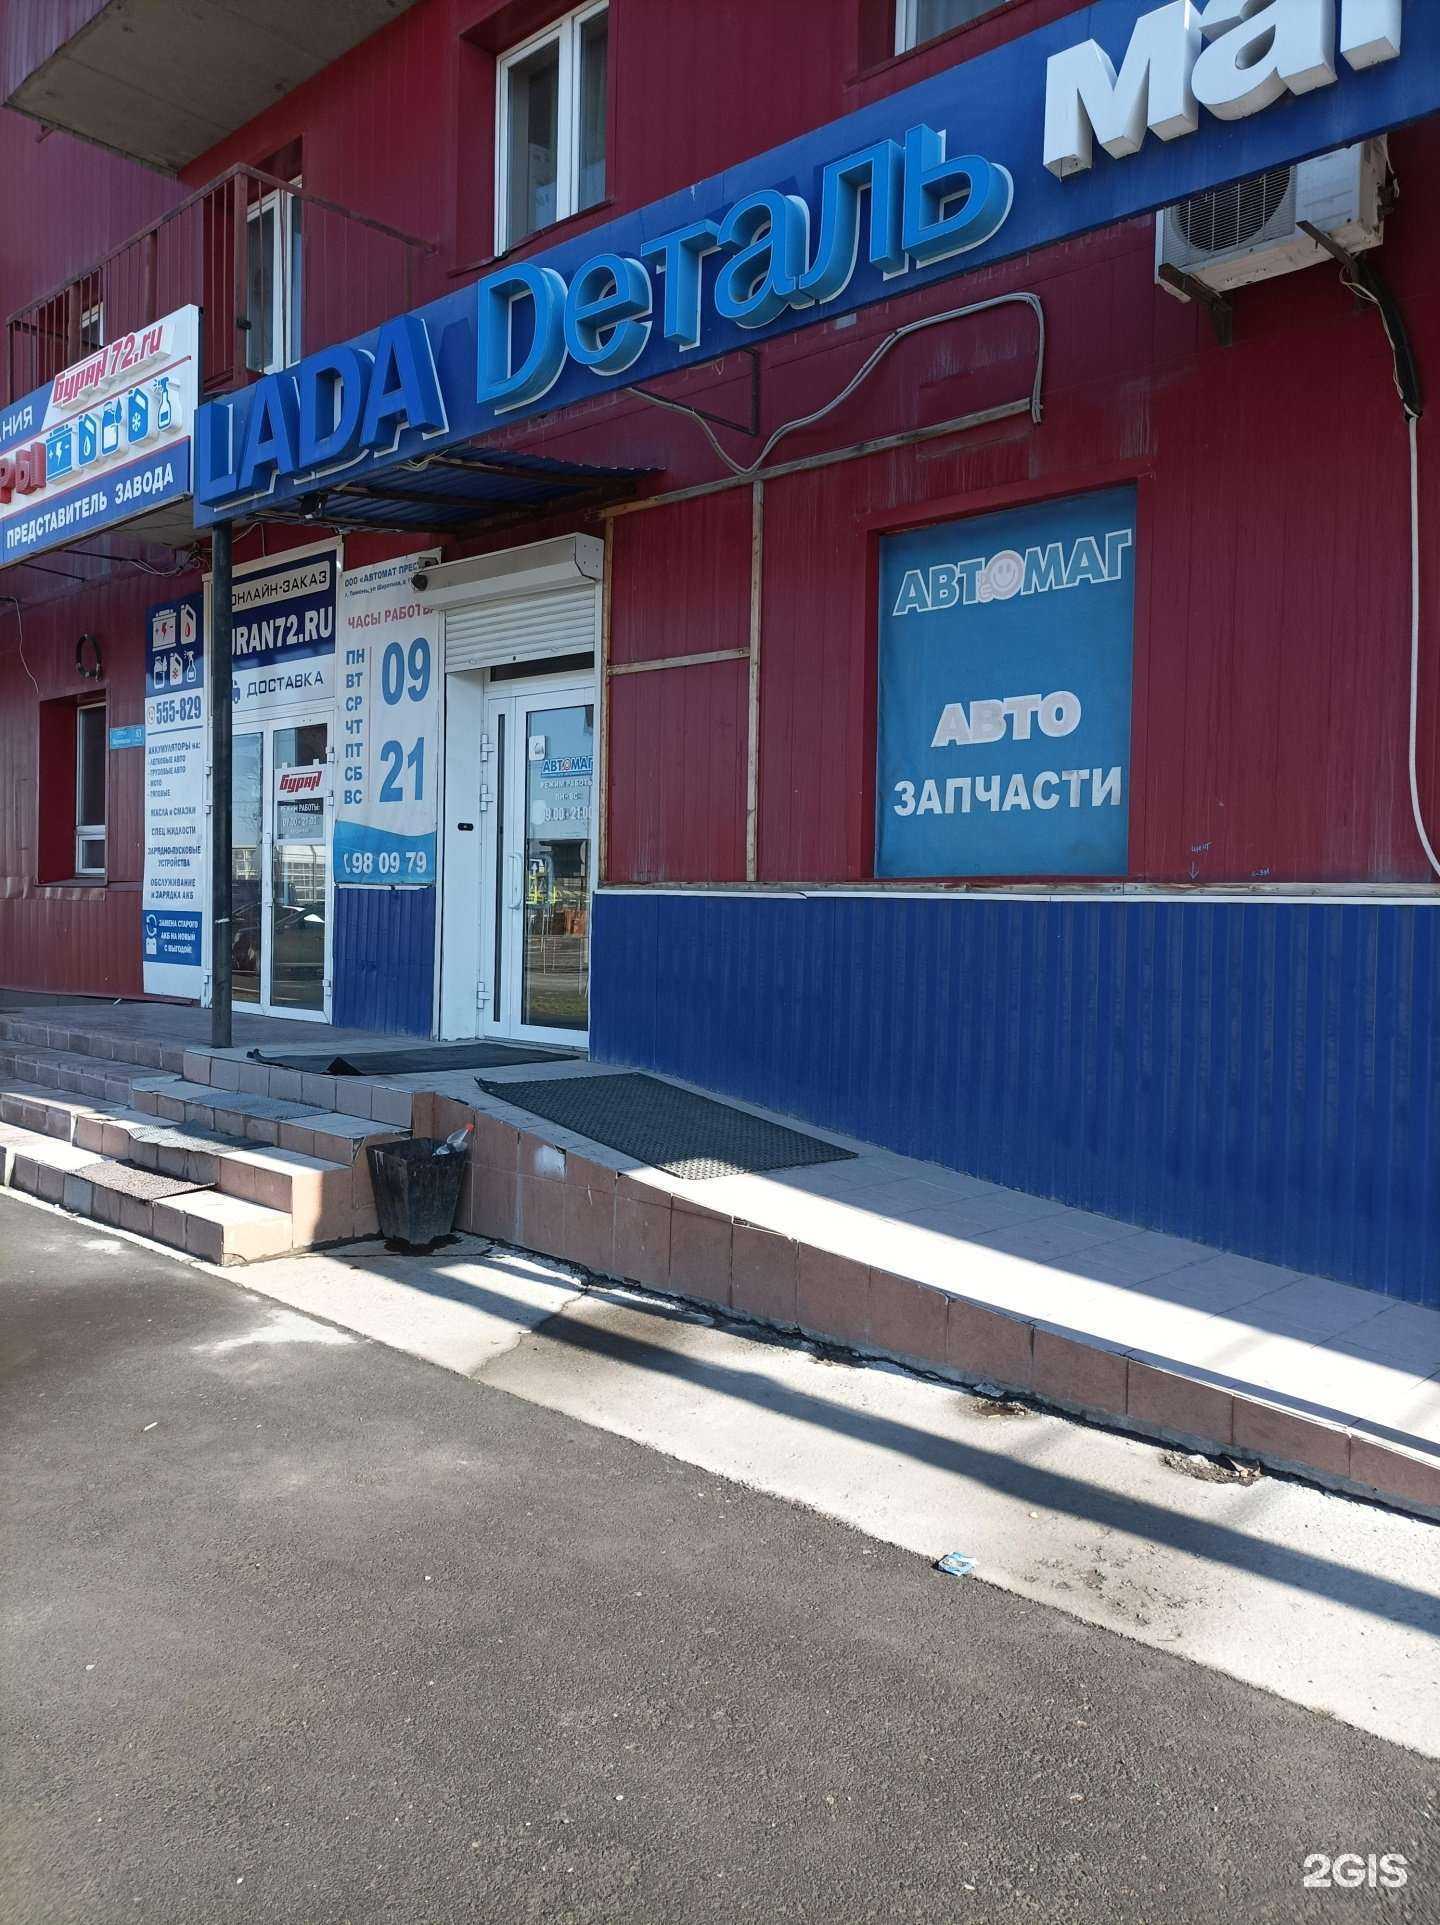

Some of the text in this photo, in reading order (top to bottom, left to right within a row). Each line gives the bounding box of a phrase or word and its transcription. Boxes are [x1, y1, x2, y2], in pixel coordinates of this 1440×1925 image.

[194, 314, 449, 512] LADA
[0, 405, 33, 441] НИЯ
[6, 462, 174, 549] ПРЕДСТАВИТЕЛЬ ЗАВОДА
[892, 528, 1132, 616] АВТОМАГ
[347, 611, 381, 630] ЧАСЫ
[345, 649, 365, 665] ПН
[345, 671, 363, 688] ВТ
[381, 637, 431, 706] 09
[246, 671, 324, 698] ДОСТАВКА
[155, 695, 202, 725] 555-829
[345, 695, 363, 712] СР
[345, 719, 363, 735] ЧТ
[930, 690, 1082, 748] АВТО
[148, 741, 191, 754] АККУМУЛЯТОРЫ
[345, 743, 363, 759] ПТ
[344, 766, 363, 782] СБ
[379, 736, 425, 803] 21
[344, 789, 362, 805] ВС
[893, 766, 1122, 817] ЗАПЧАСТИ
[158, 857, 191, 868] УСТРОЙСТВА
[352, 851, 427, 874] 98 09 79
[150, 878, 197, 888] ОБСЛУЖИВАНИЕ
[182, 891, 194, 900] АКБ
[160, 931, 171, 941] АКБ
